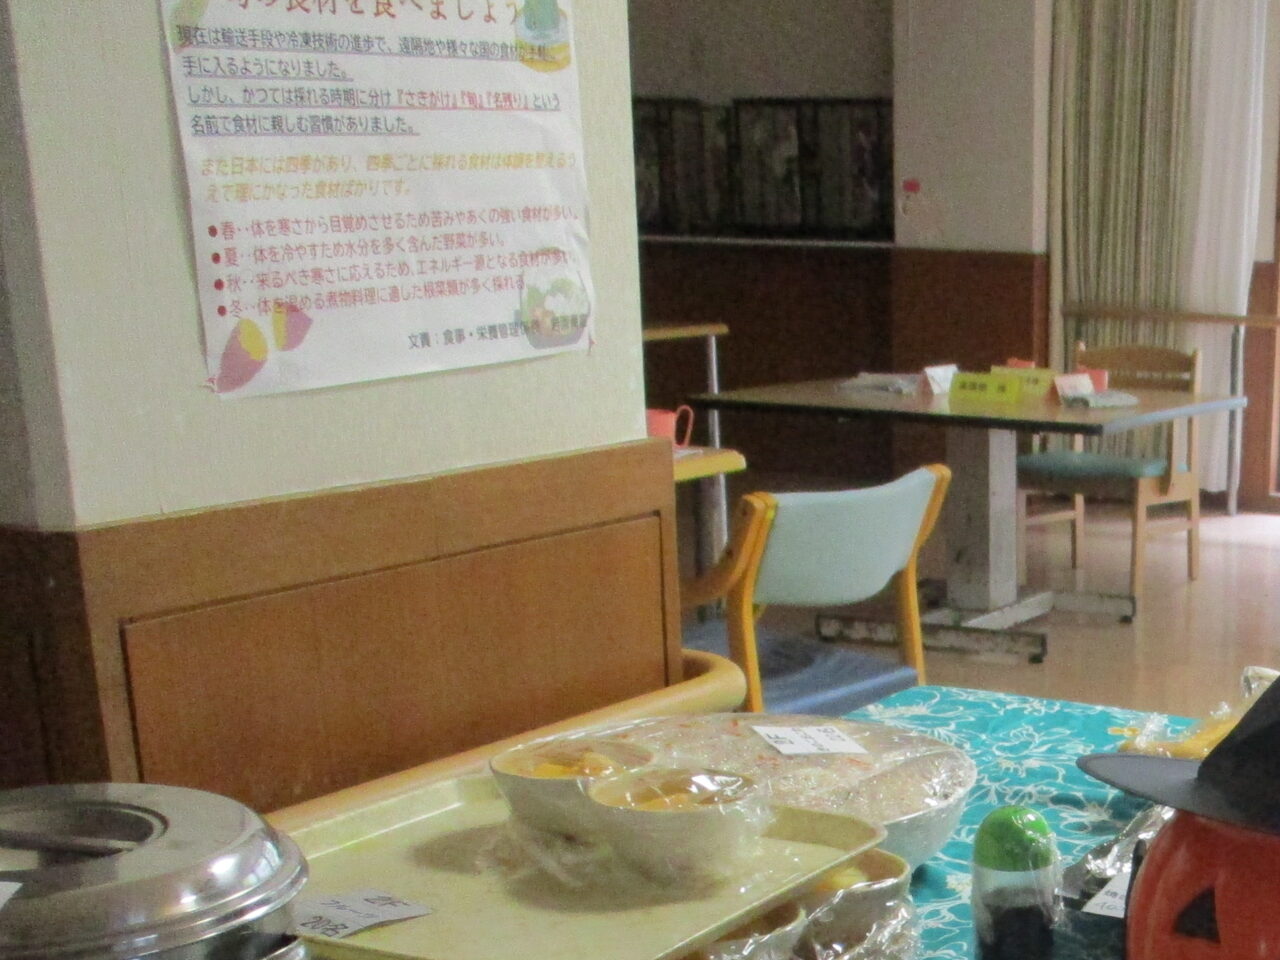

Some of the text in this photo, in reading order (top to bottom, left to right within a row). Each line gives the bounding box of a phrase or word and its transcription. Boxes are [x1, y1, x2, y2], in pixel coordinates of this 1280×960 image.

[182, 56, 348, 79] 手に入るようになりました。
